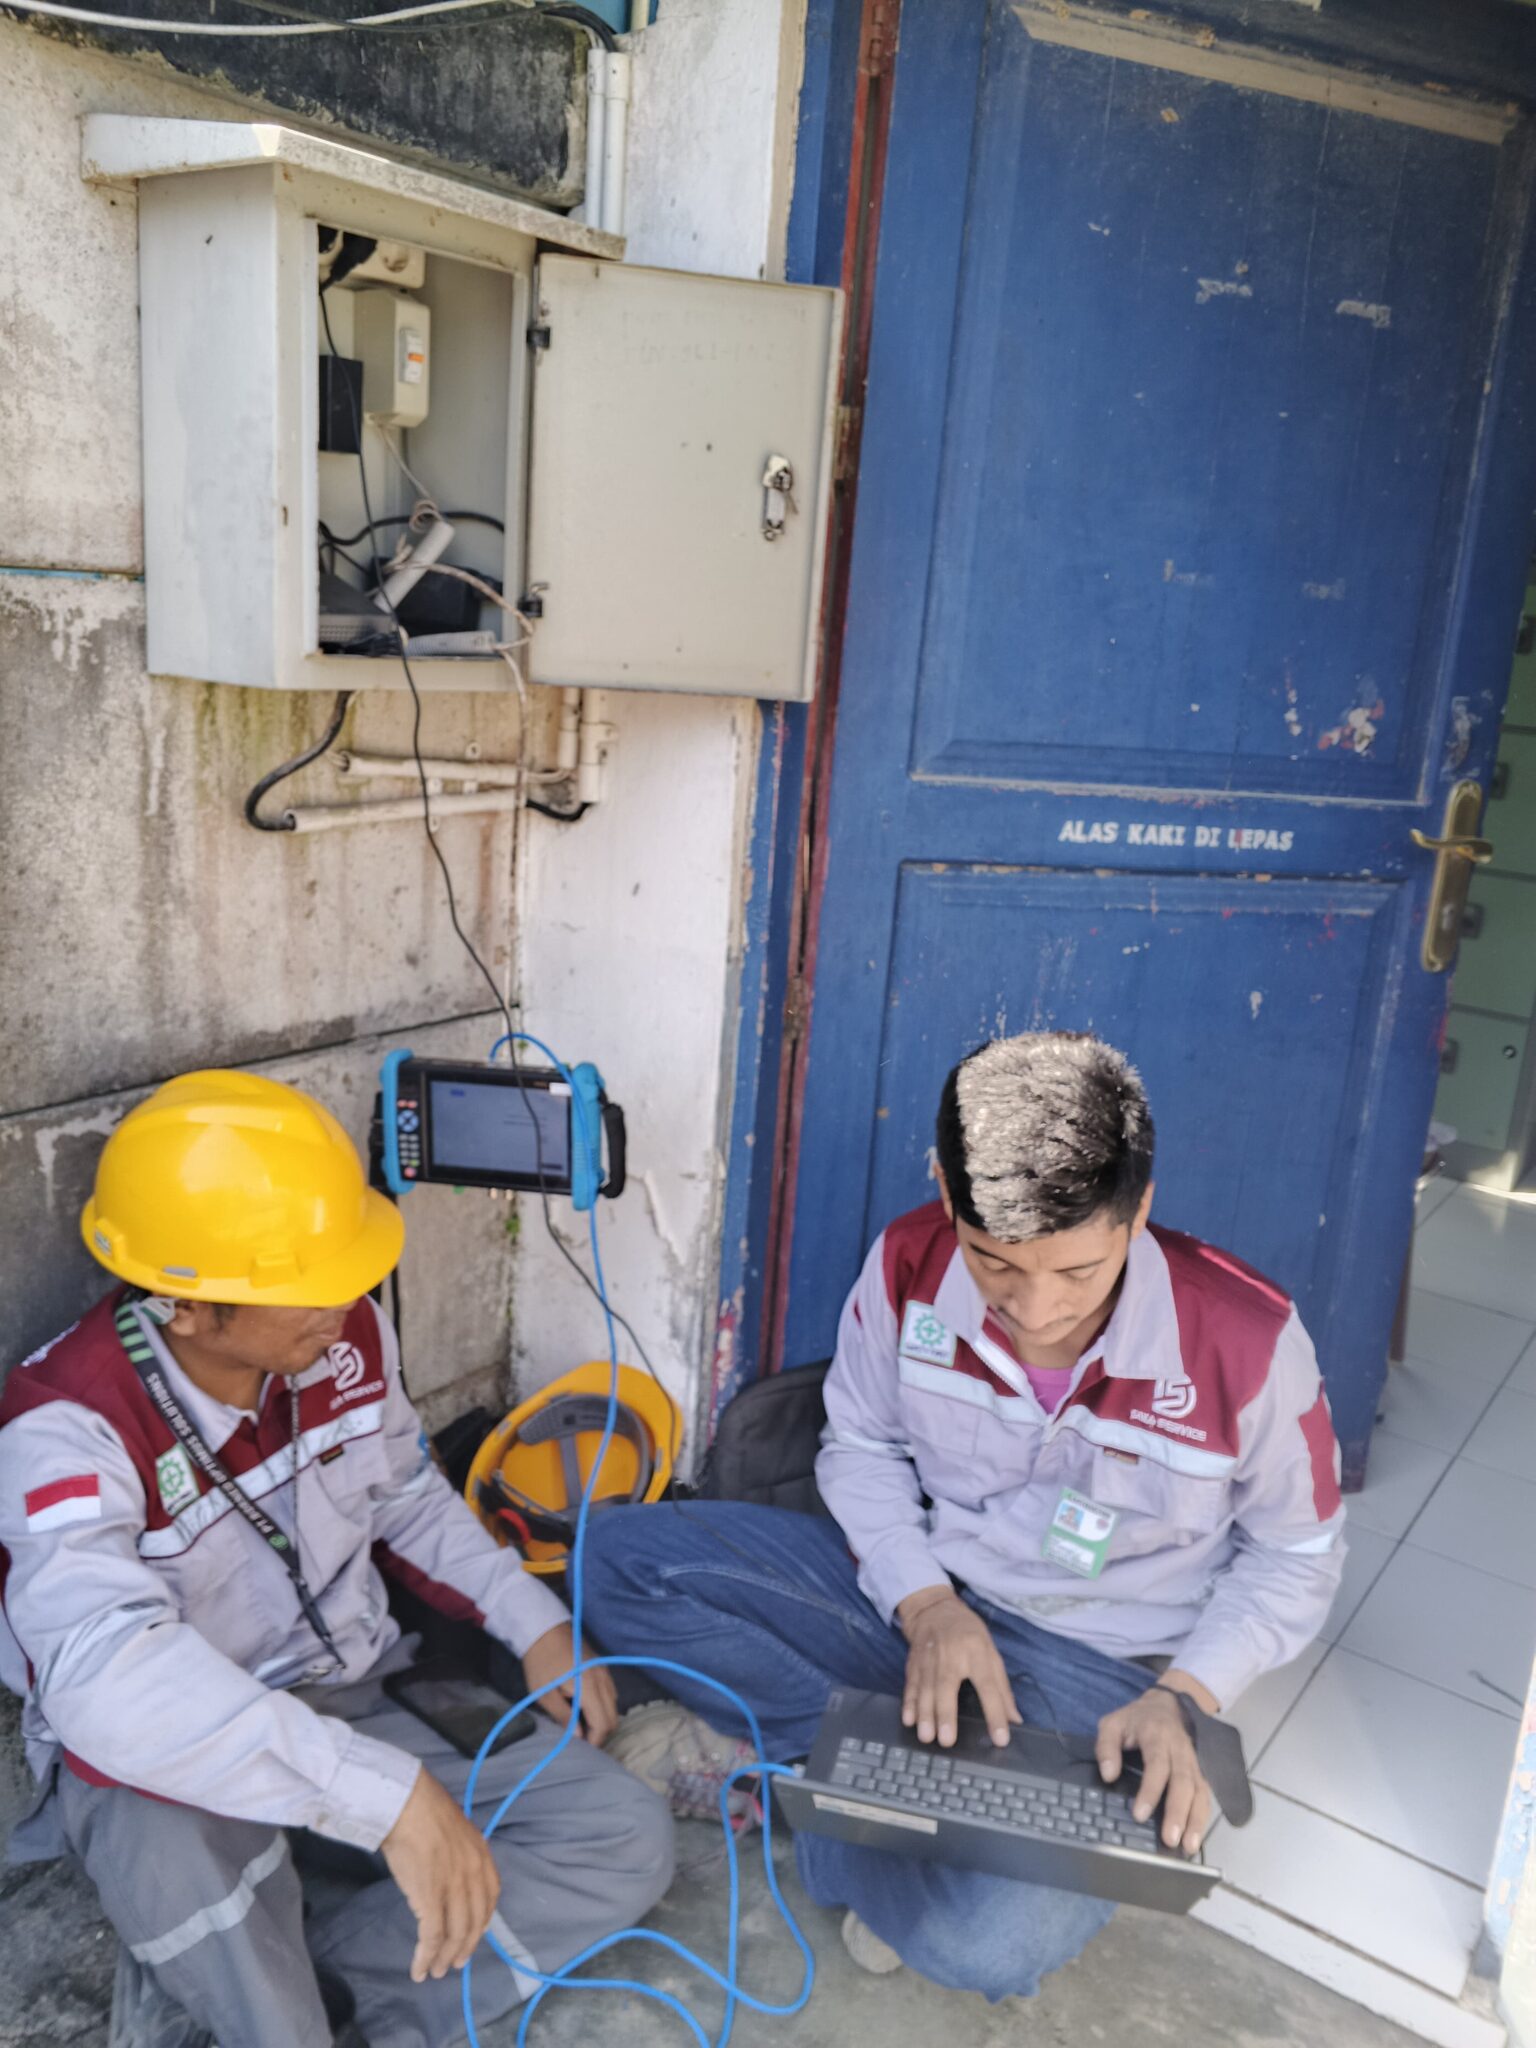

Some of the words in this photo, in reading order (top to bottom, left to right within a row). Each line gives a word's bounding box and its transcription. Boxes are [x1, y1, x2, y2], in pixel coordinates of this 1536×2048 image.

[1058, 820, 1119, 844] ALAS
[1127, 823, 1187, 847] KAKI
[1194, 825, 1223, 848] DI
[1228, 828, 1295, 852] LEPAS
[146, 1372, 193, 1437] SOLUTIONS
